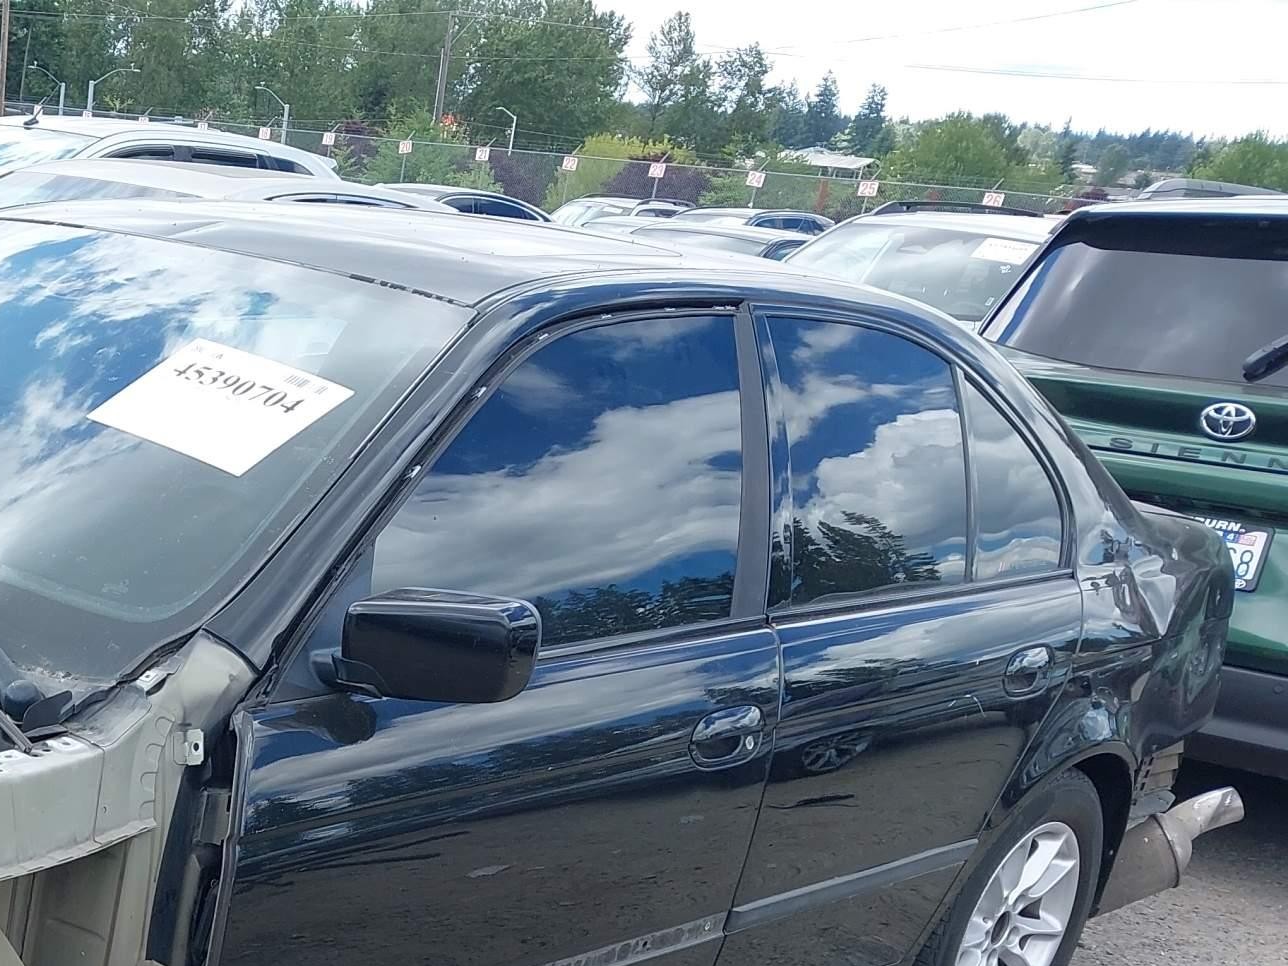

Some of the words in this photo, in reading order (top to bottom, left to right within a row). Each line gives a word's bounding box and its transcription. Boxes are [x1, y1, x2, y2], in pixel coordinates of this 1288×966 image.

[400, 141, 411, 152] 20
[477, 149, 487, 159] 21
[564, 158, 576, 169] 22
[651, 165, 663, 175] 23
[749, 173, 762, 185] 24
[861, 182, 875, 195] 25
[985, 193, 1000, 206] 26
[173, 362, 305, 414] 45390704
[1194, 515, 1246, 533] URN.
